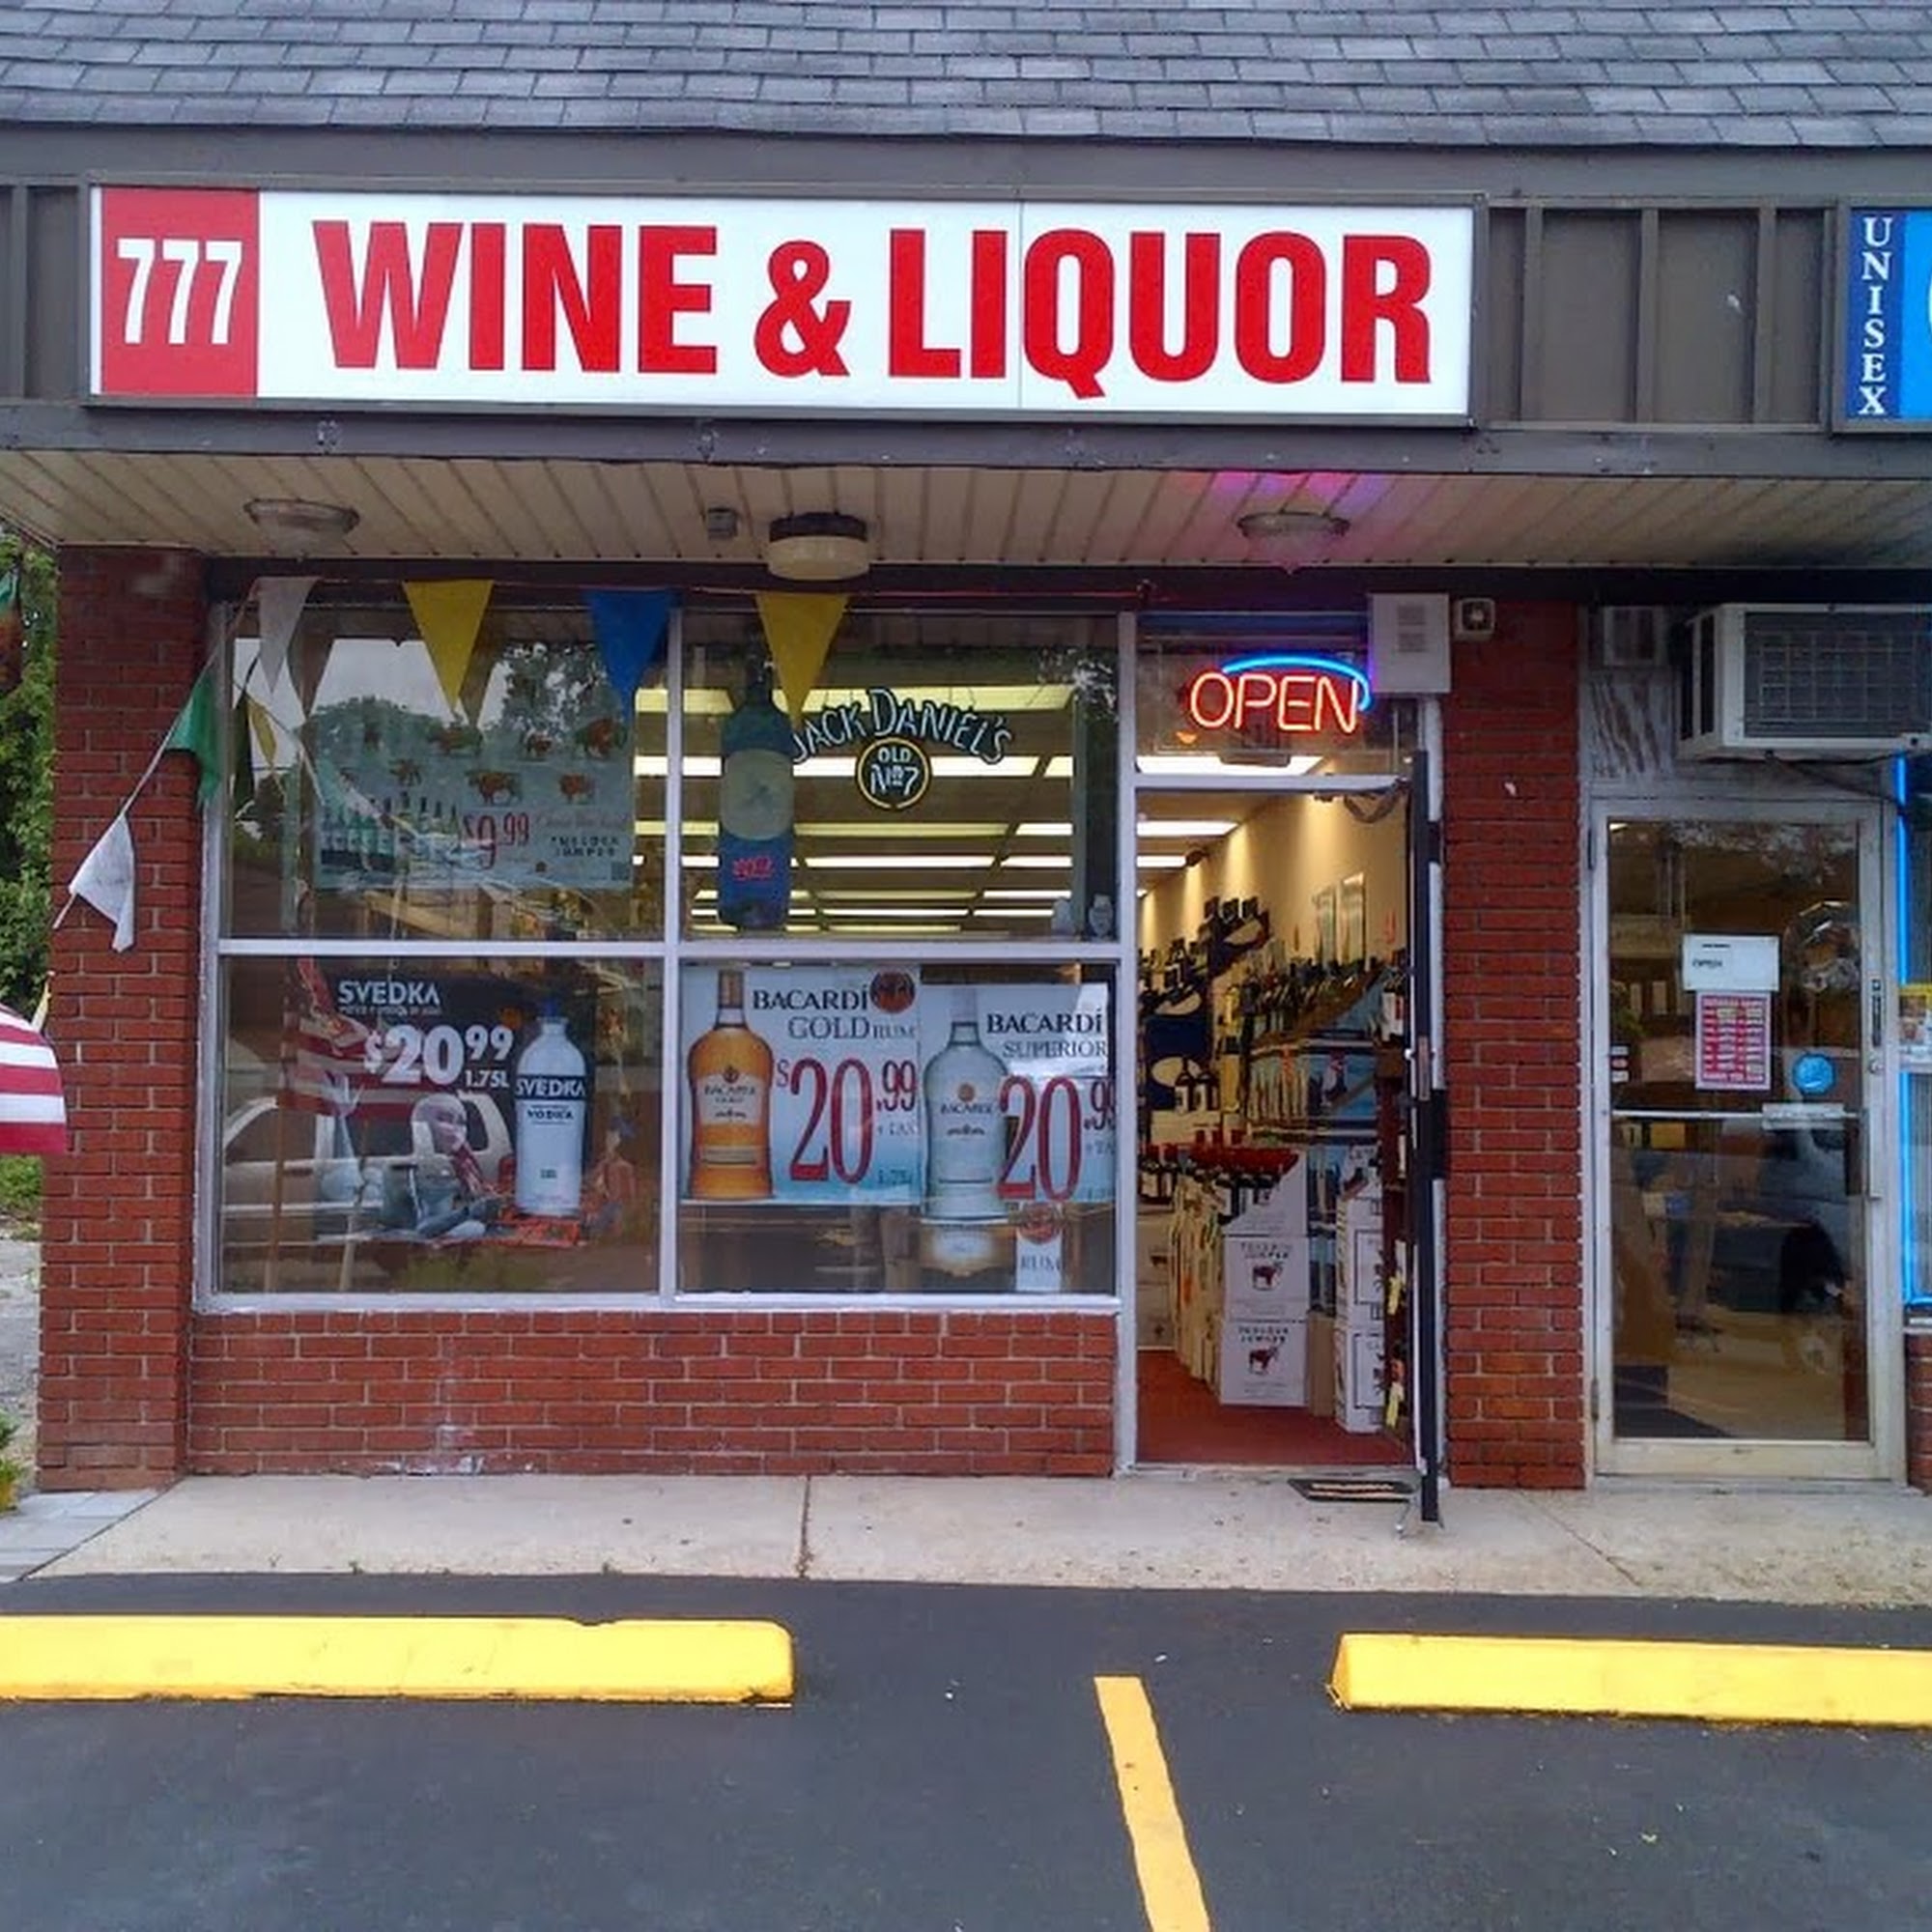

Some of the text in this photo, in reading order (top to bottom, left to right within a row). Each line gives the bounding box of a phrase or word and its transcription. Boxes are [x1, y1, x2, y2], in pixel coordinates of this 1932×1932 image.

[117, 219, 1432, 399] 777 WINE & LIQUOR
[1858, 216, 1893, 415] UNISEX
[1189, 671, 1358, 734] OPEN
[792, 703, 867, 763] JACK
[877, 747, 912, 762] OLD
[338, 980, 441, 1006] SVEDKA
[787, 1015, 869, 1039] GOLD
[1002, 1039, 1108, 1059] SUPERIOR
[516, 1078, 586, 1097] SVEDKA
